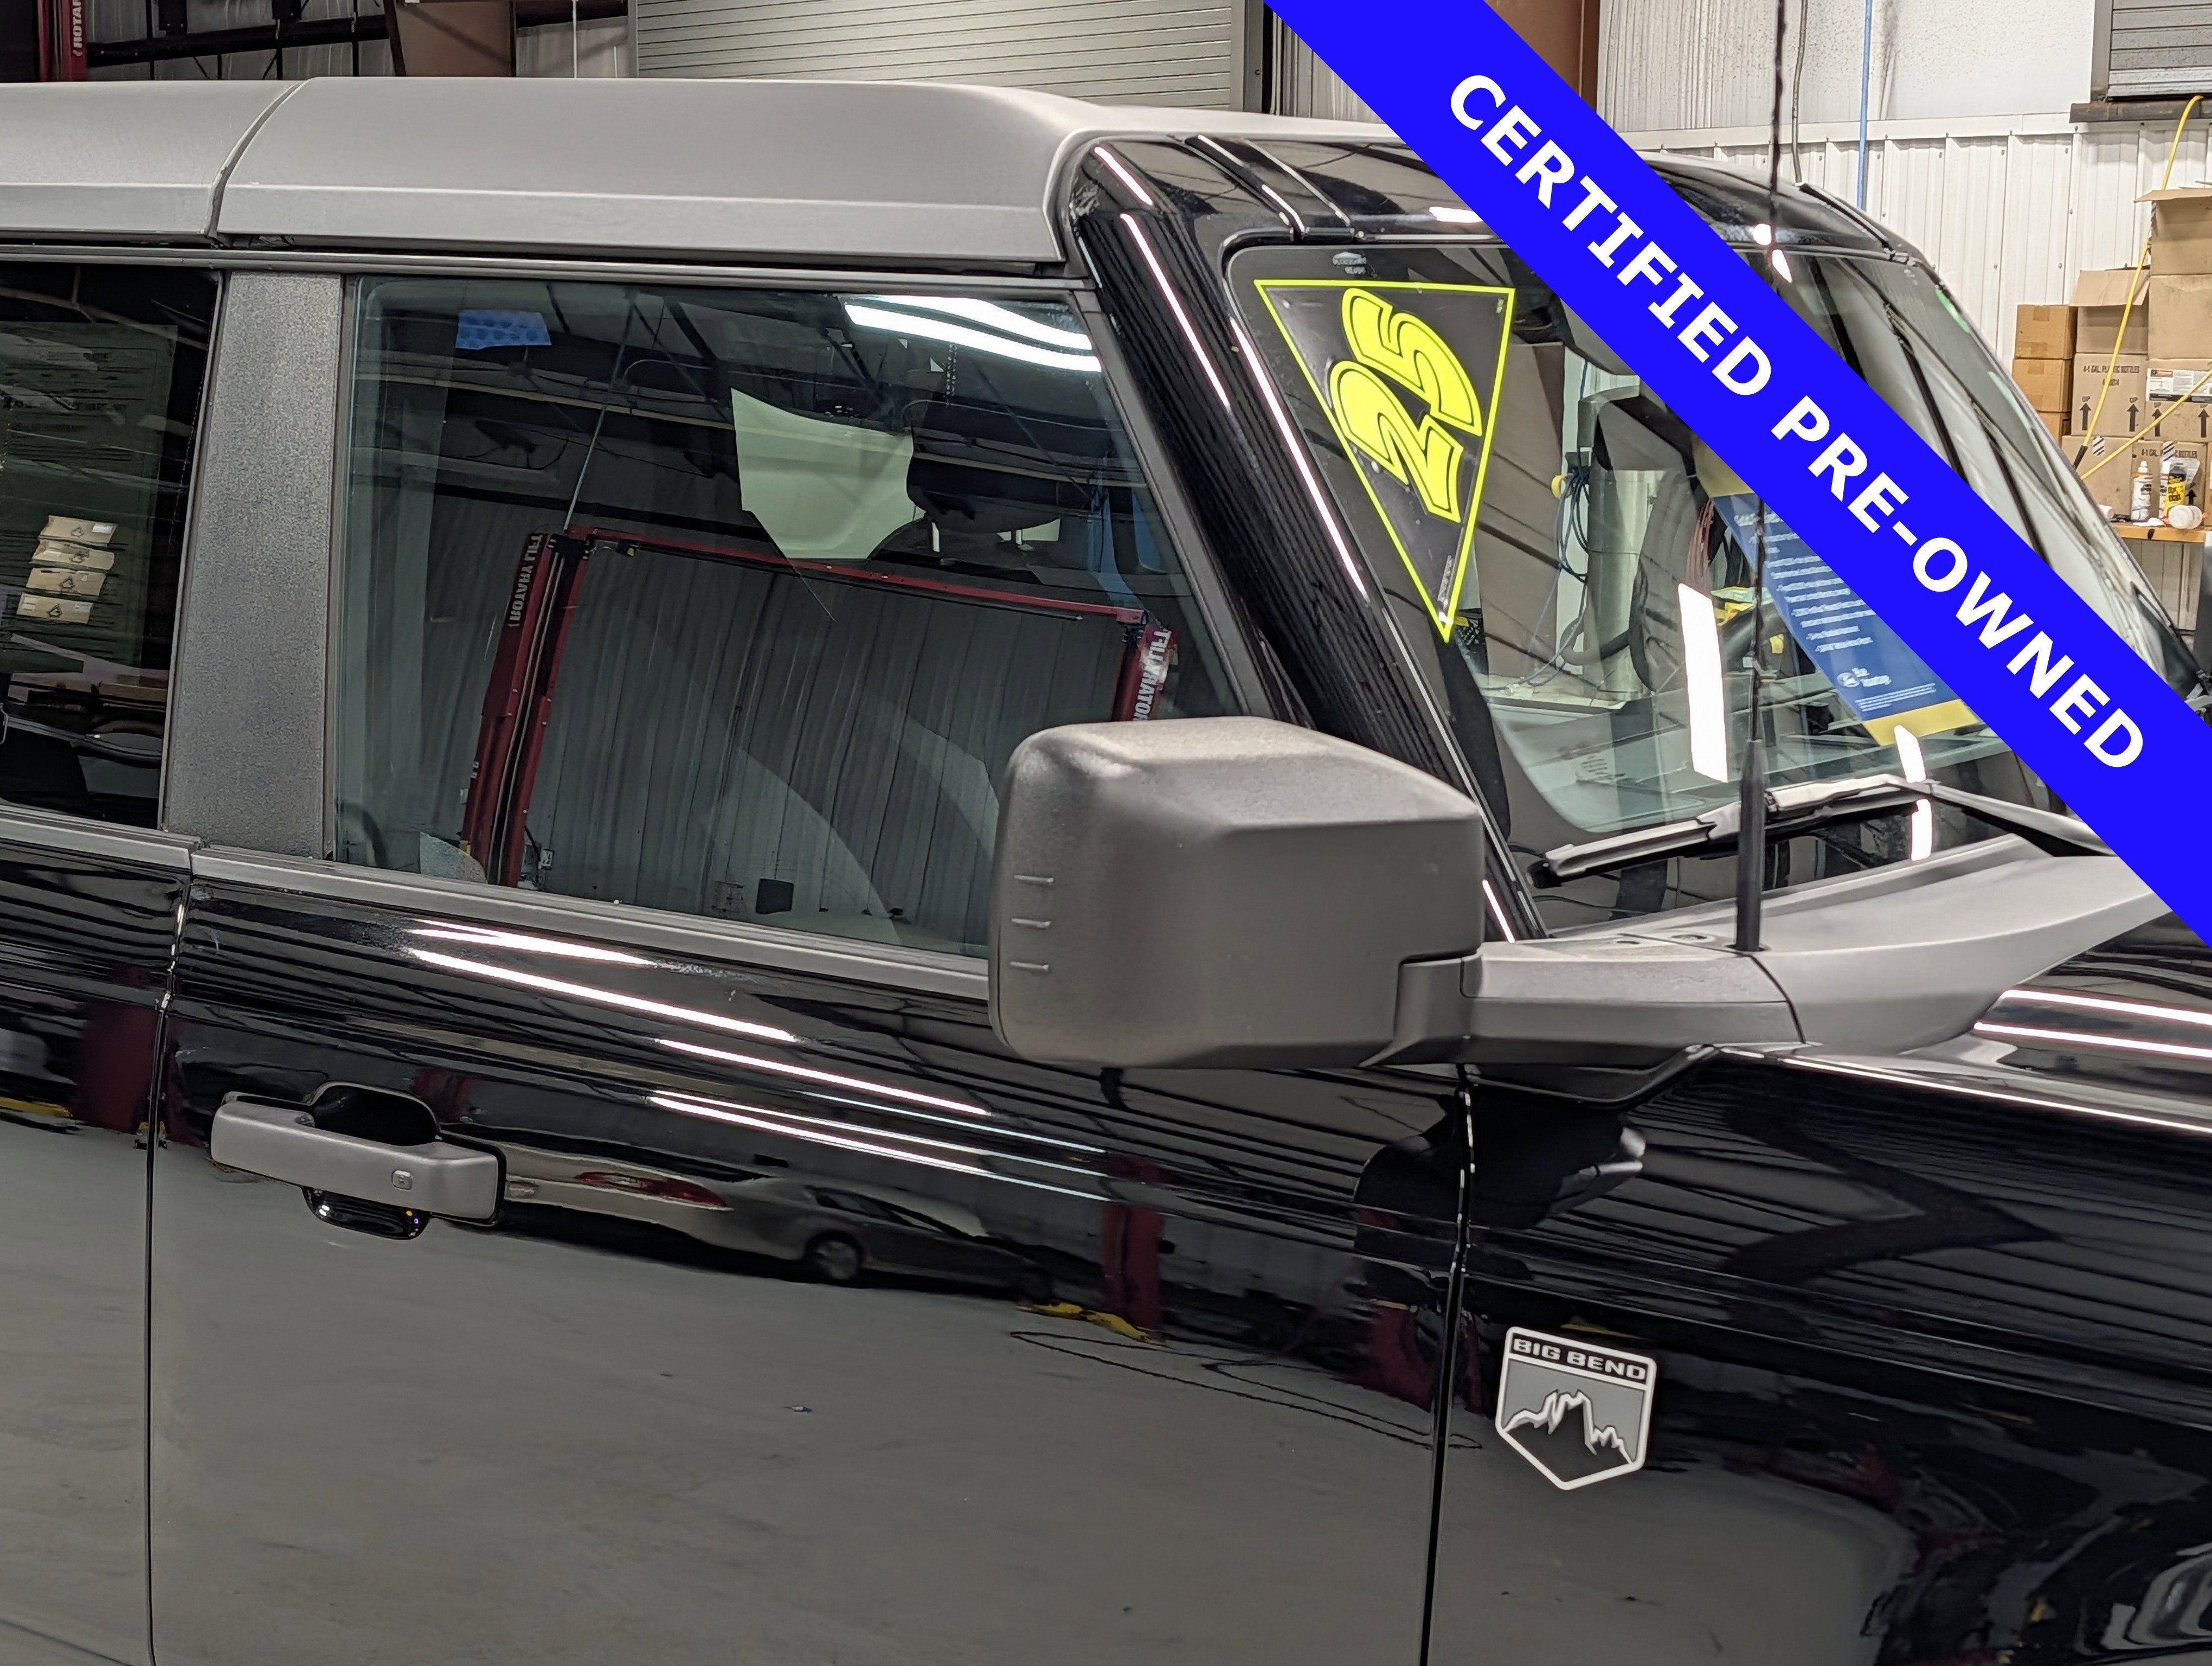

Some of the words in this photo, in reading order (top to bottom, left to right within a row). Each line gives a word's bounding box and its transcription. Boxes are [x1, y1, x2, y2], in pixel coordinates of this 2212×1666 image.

[1329, 288, 1482, 523] 25
[1513, 1338, 1561, 1361] BIG
[1566, 1351, 1646, 1380] BEND
